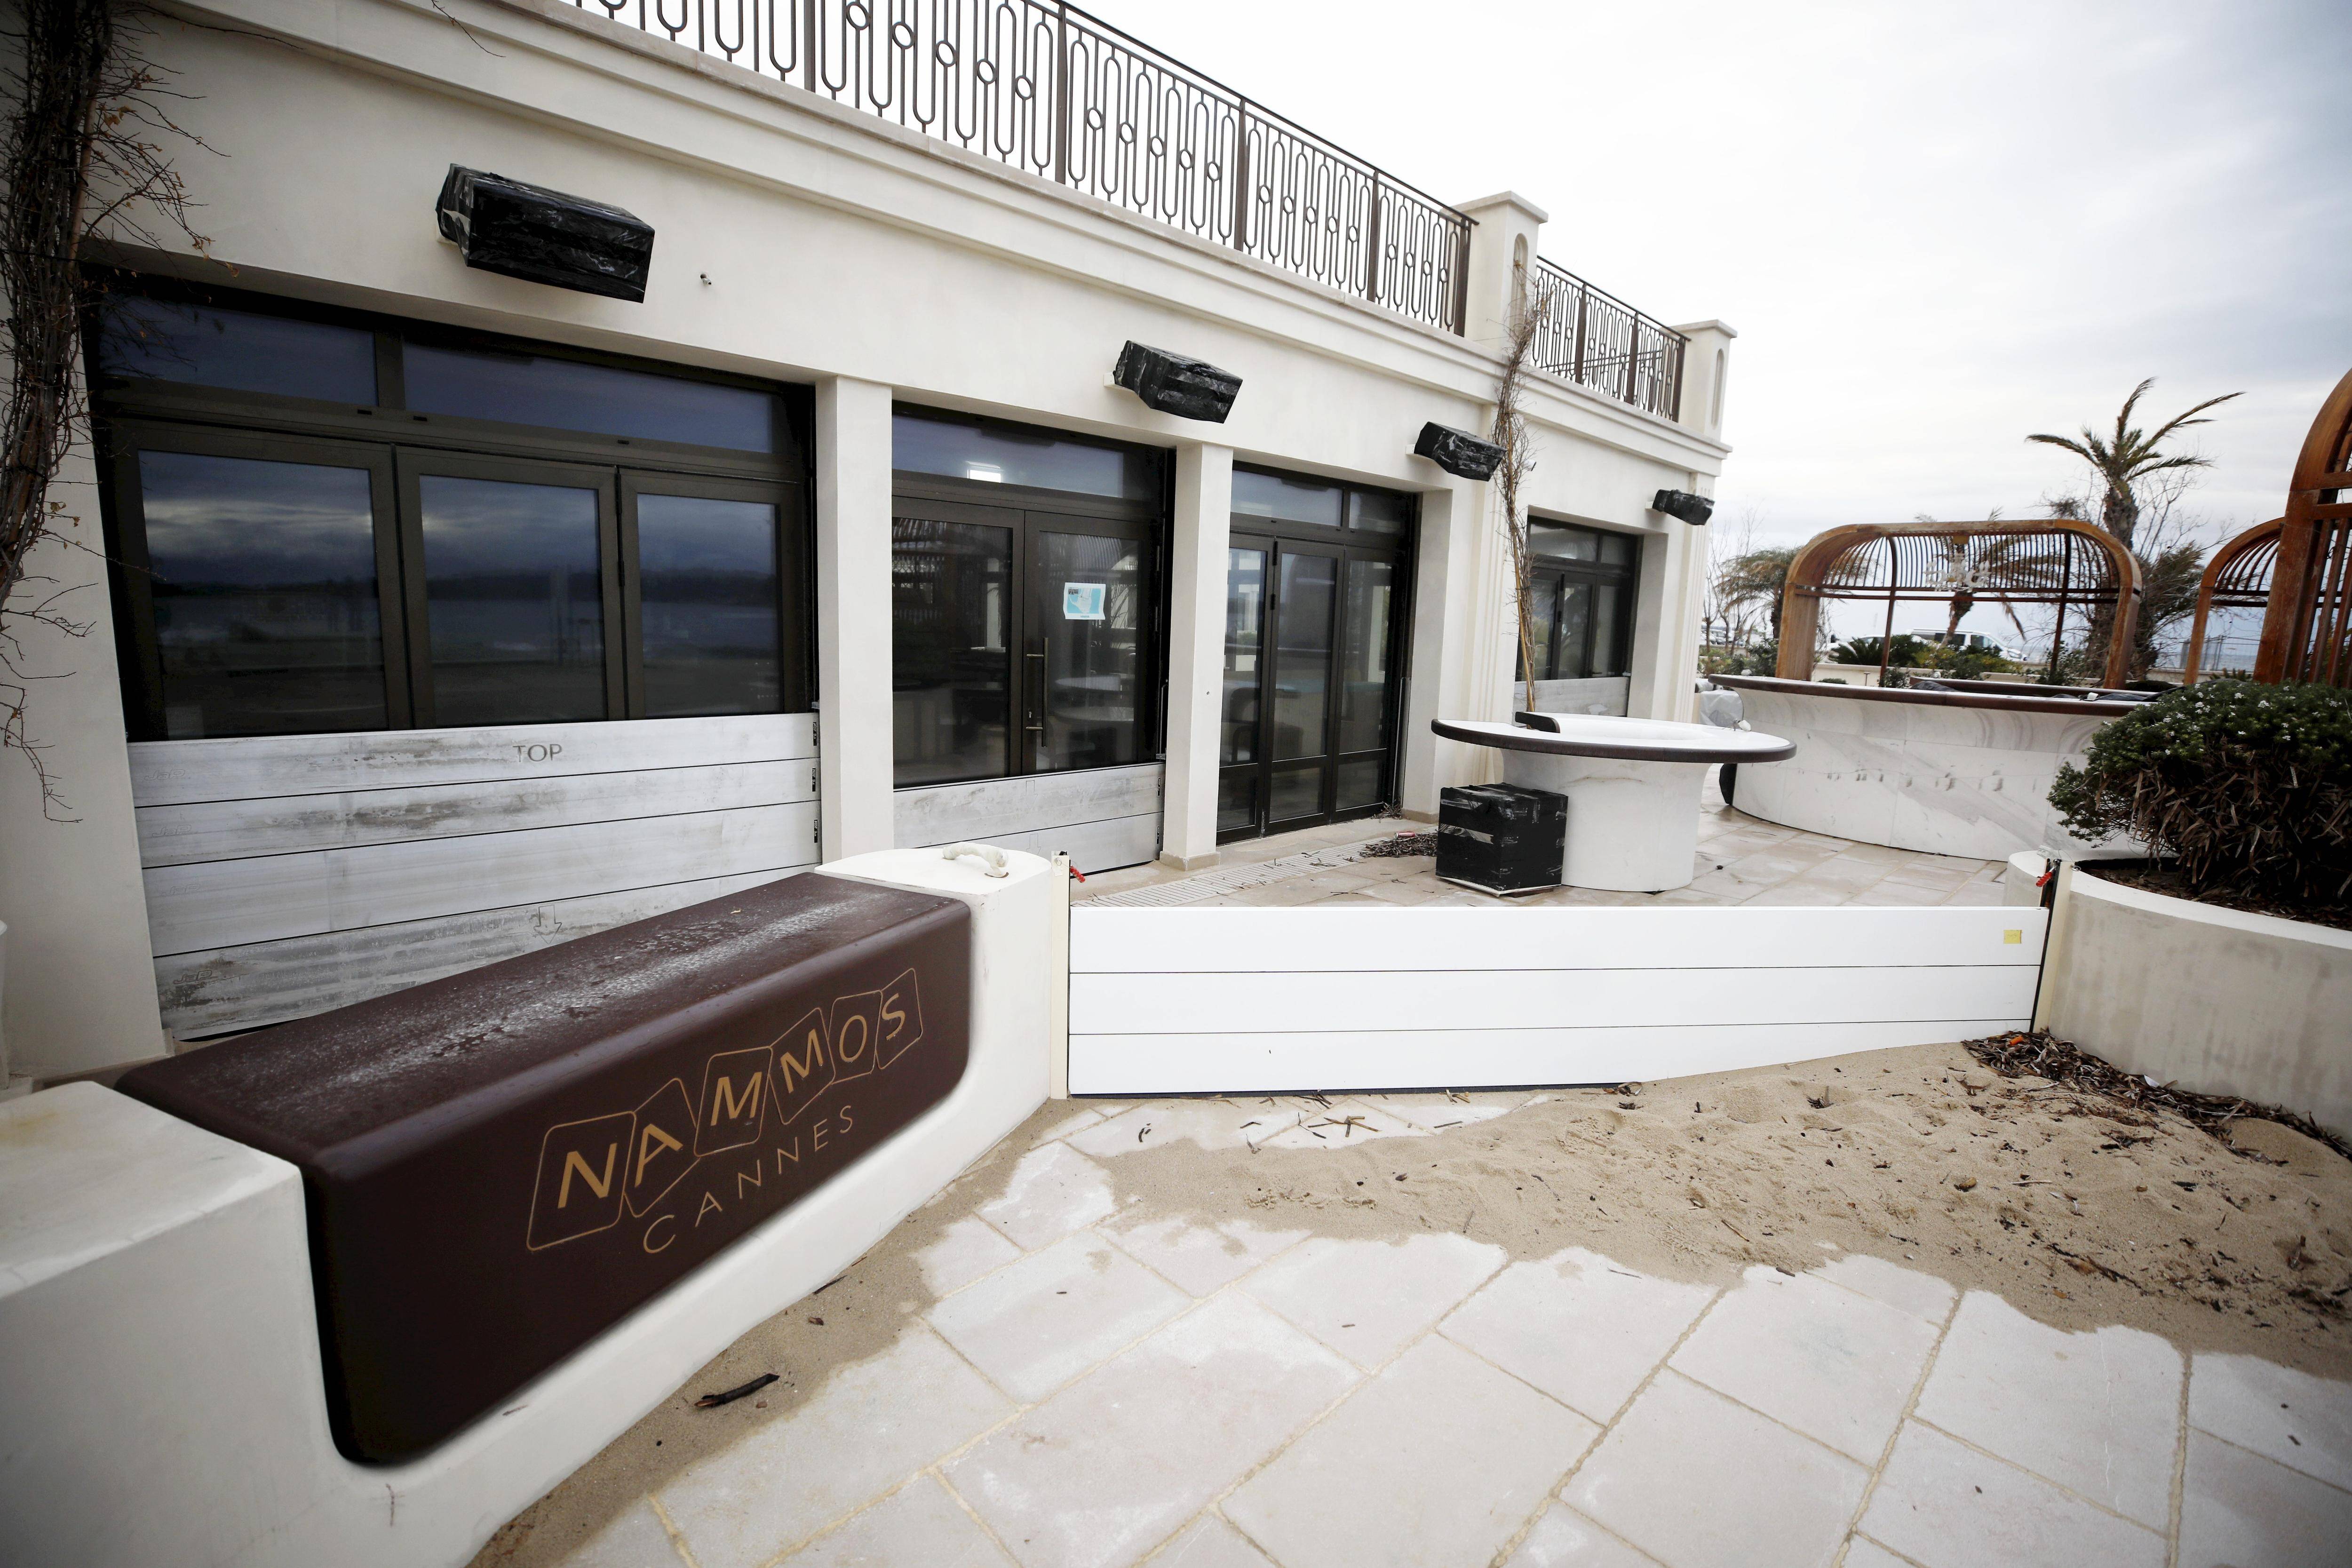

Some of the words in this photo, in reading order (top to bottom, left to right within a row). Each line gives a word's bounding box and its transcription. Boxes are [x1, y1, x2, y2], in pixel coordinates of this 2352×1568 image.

[512, 743, 562, 763] TOP
[557, 993, 906, 1209] NAMMOS
[643, 1105, 852, 1254] CANNES
